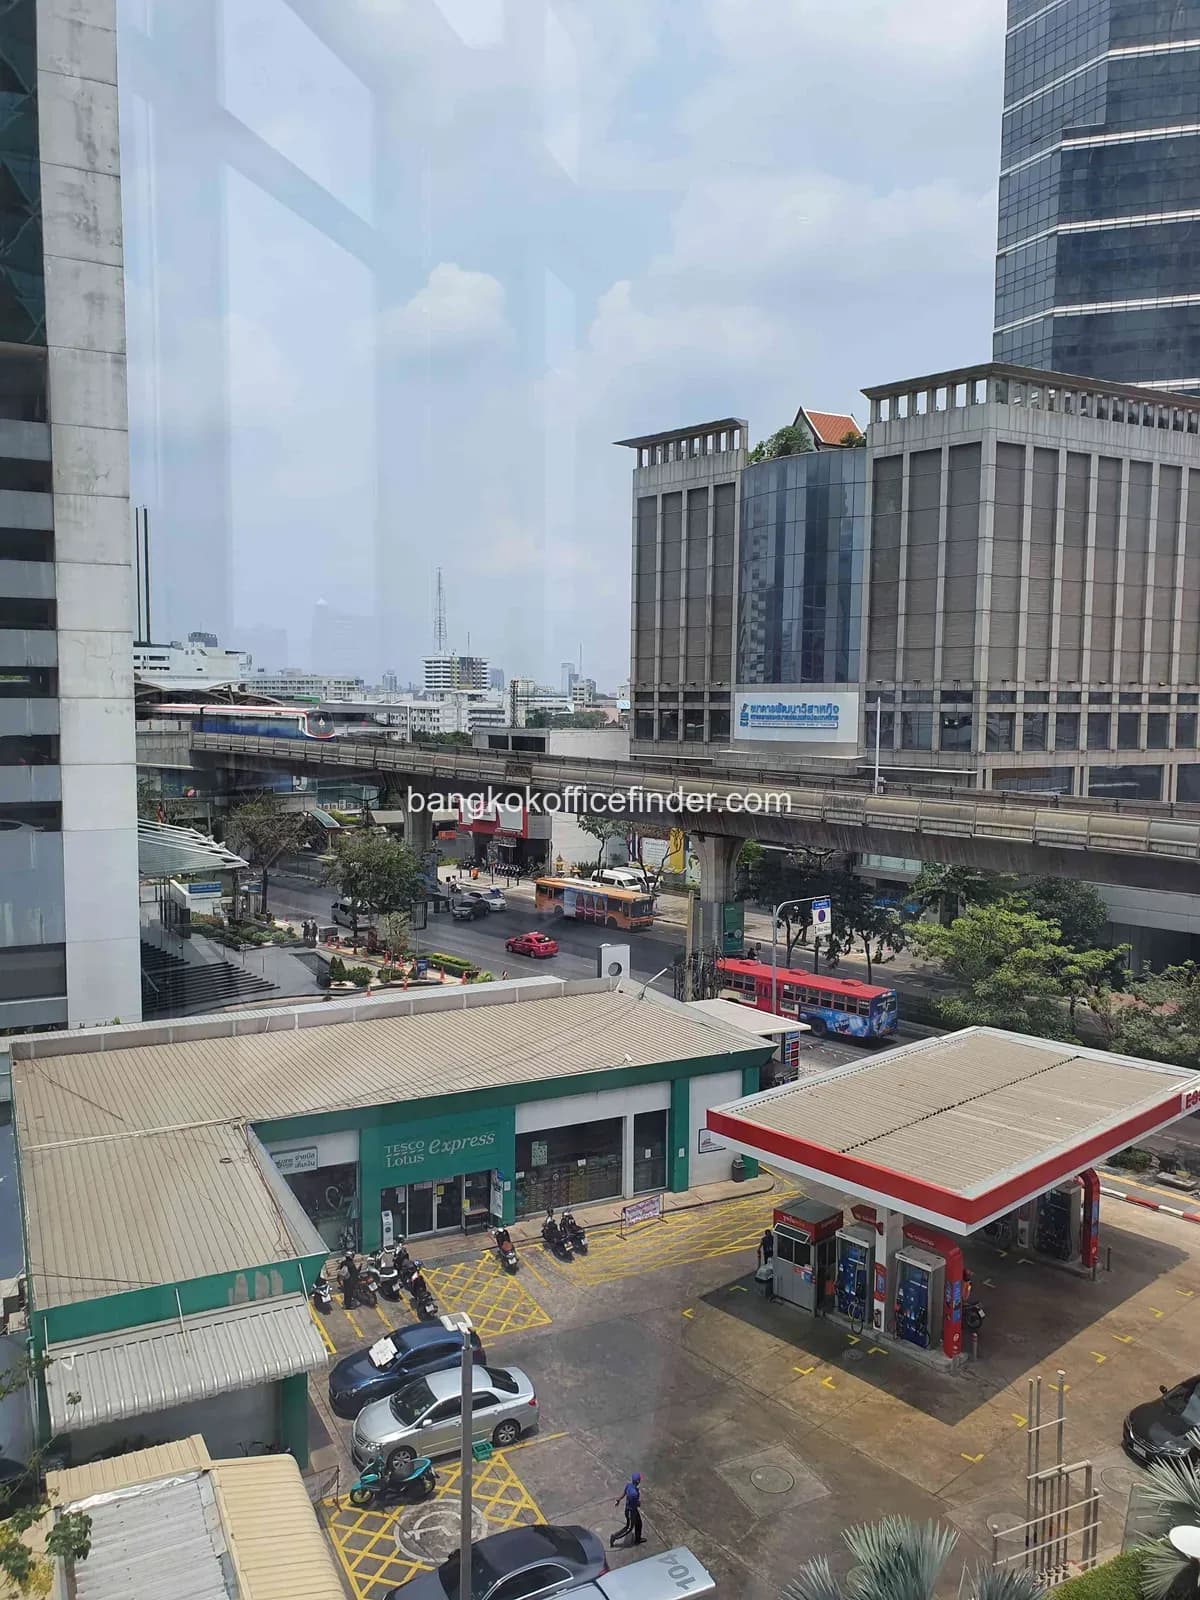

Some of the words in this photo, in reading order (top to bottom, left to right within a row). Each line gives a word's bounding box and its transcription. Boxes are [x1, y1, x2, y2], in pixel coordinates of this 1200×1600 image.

[384, 1140, 425, 1154] TESCO
[428, 1131, 496, 1154] express
[387, 1153, 425, 1168] Lotus
